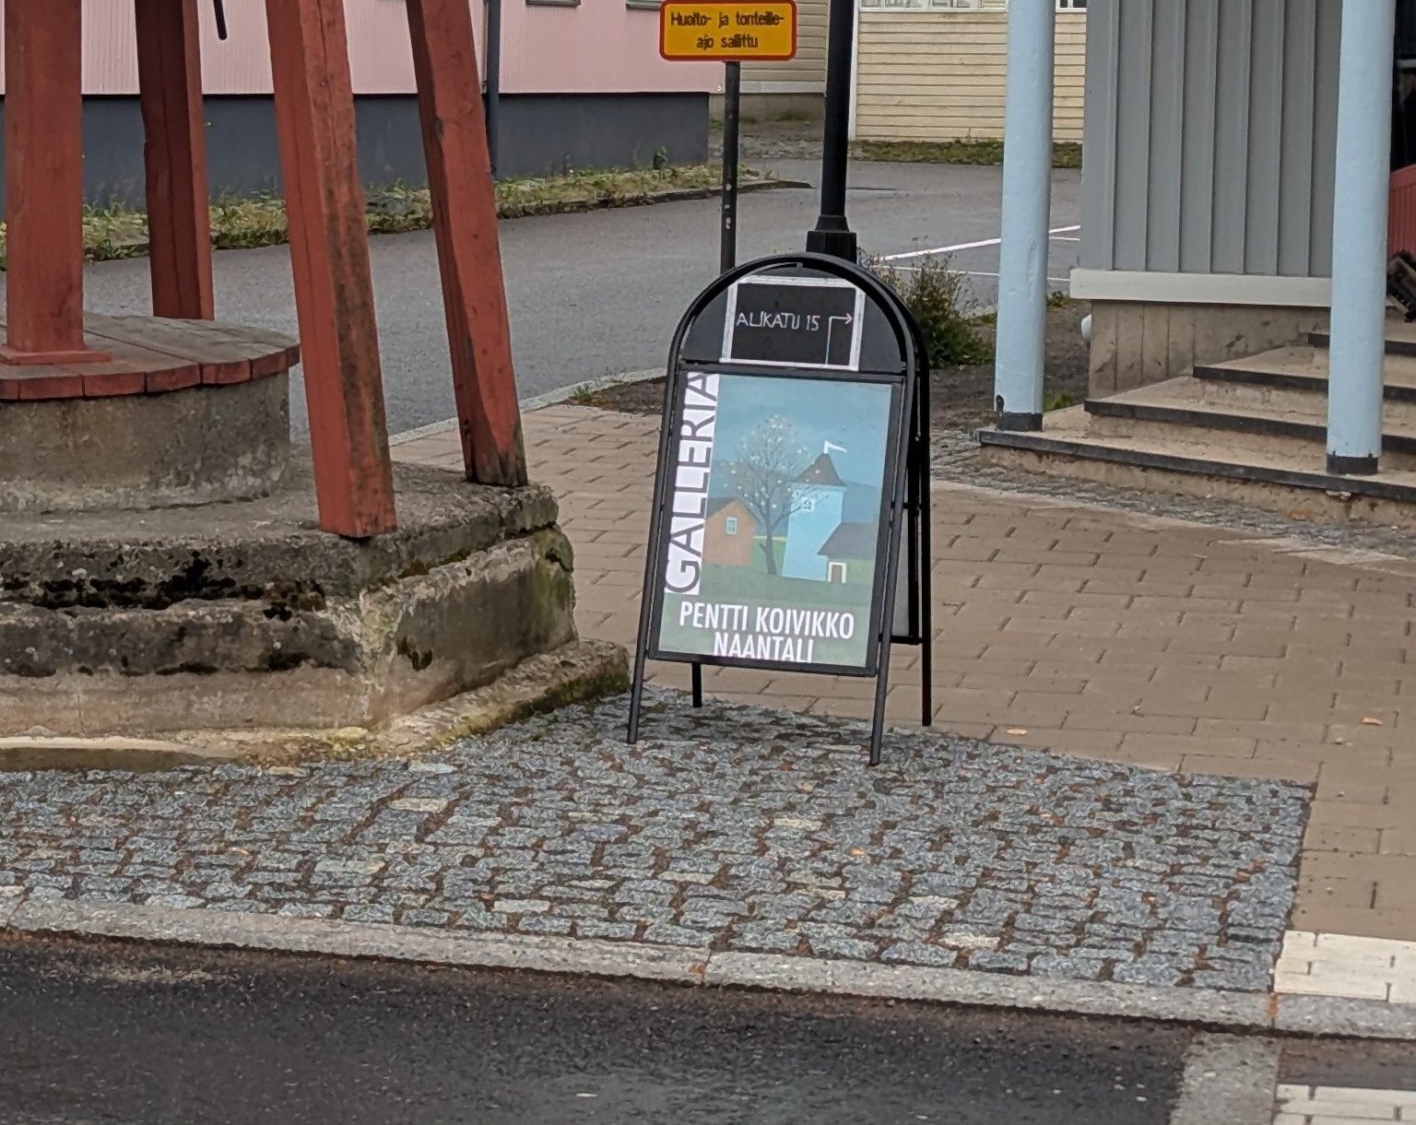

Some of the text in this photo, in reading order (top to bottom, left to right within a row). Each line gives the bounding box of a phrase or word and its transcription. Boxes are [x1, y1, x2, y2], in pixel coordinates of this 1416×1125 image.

[670, 12, 712, 26] Huolto-
[718, 11, 729, 29] ja
[696, 33, 759, 51] ajo sallittu
[736, 311, 821, 331] ALIKATU 15
[665, 372, 717, 593] GALLERIA
[679, 601, 855, 640] PENTTI KOIVIKKO
[713, 631, 814, 663] NAANTALI
